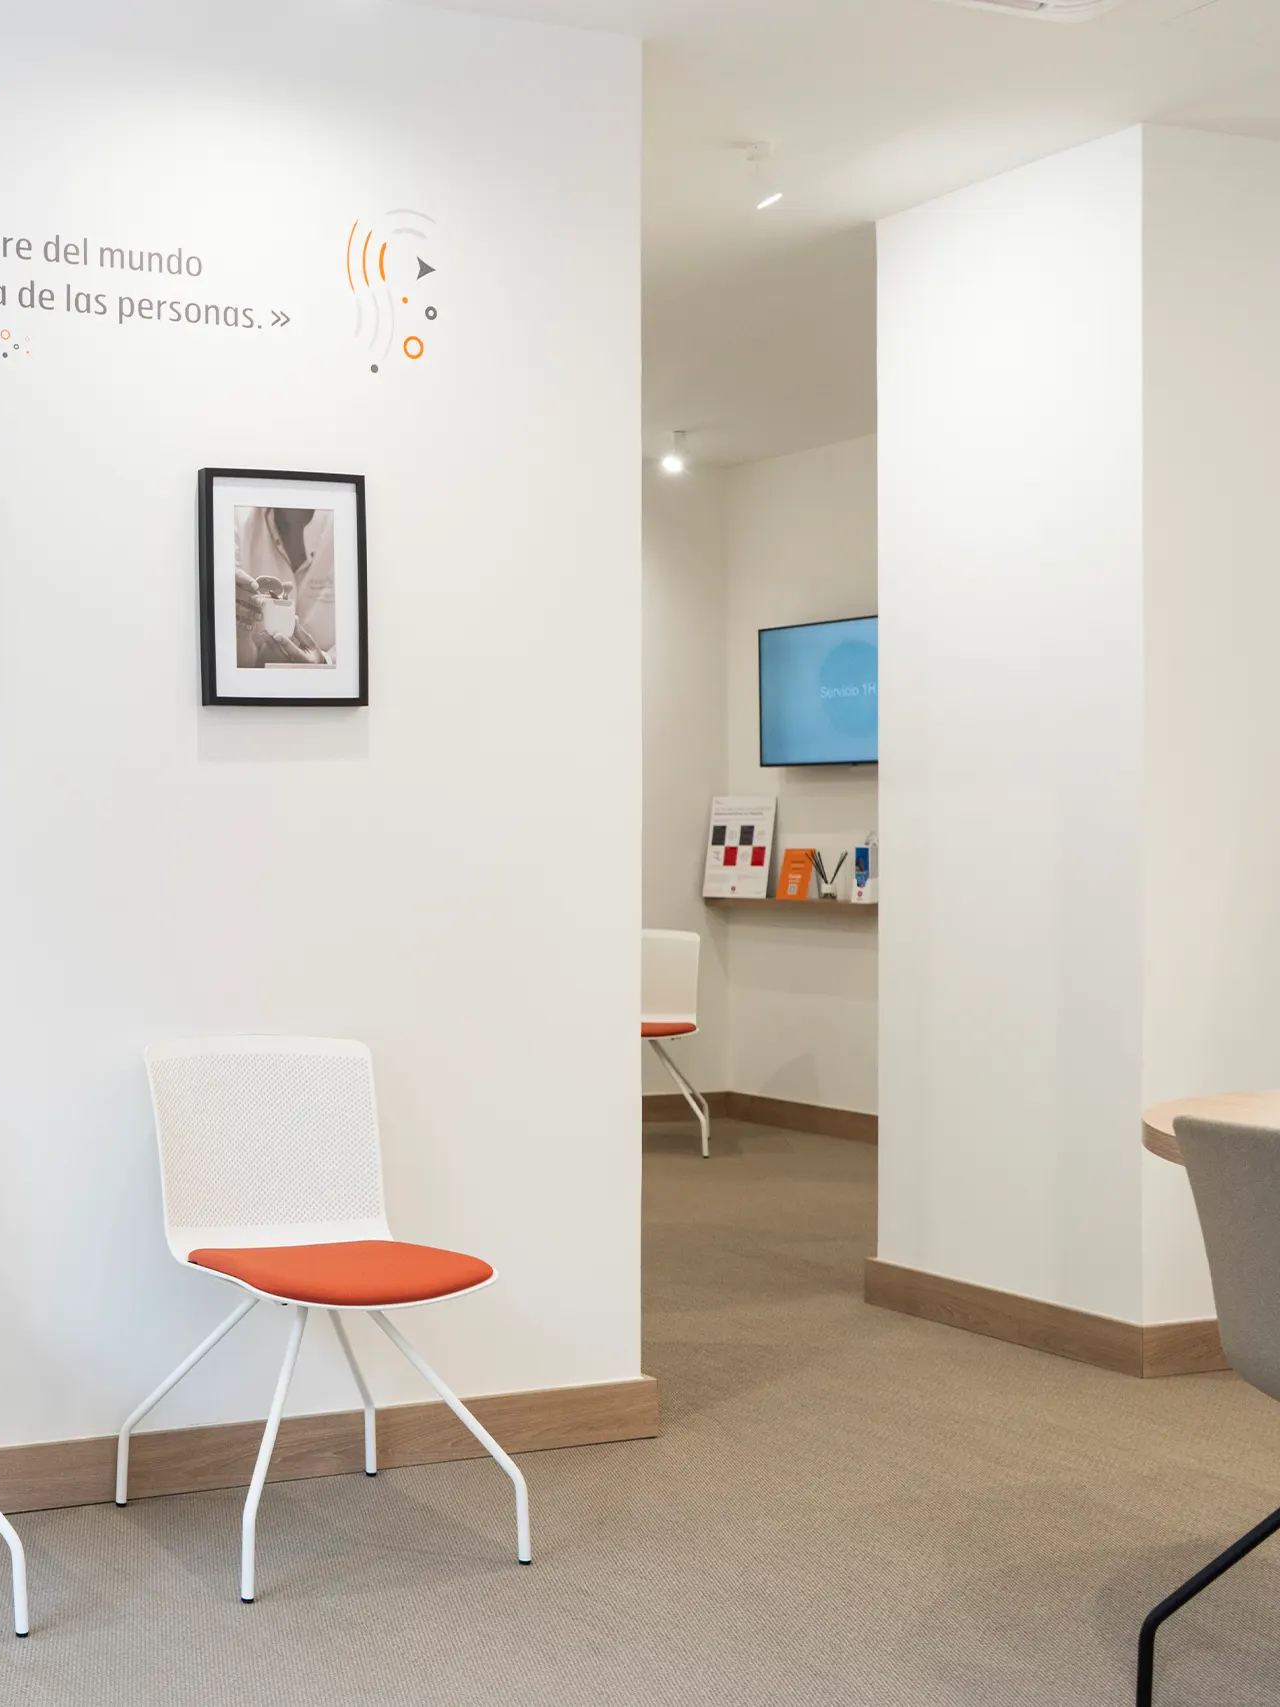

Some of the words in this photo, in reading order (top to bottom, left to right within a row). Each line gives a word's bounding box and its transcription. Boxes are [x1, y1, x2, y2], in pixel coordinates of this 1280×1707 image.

[43, 234, 88, 266] del
[99, 246, 203, 277] mundo
[17, 279, 55, 311] de
[66, 283, 108, 316] las
[118, 296, 263, 330] personas.
